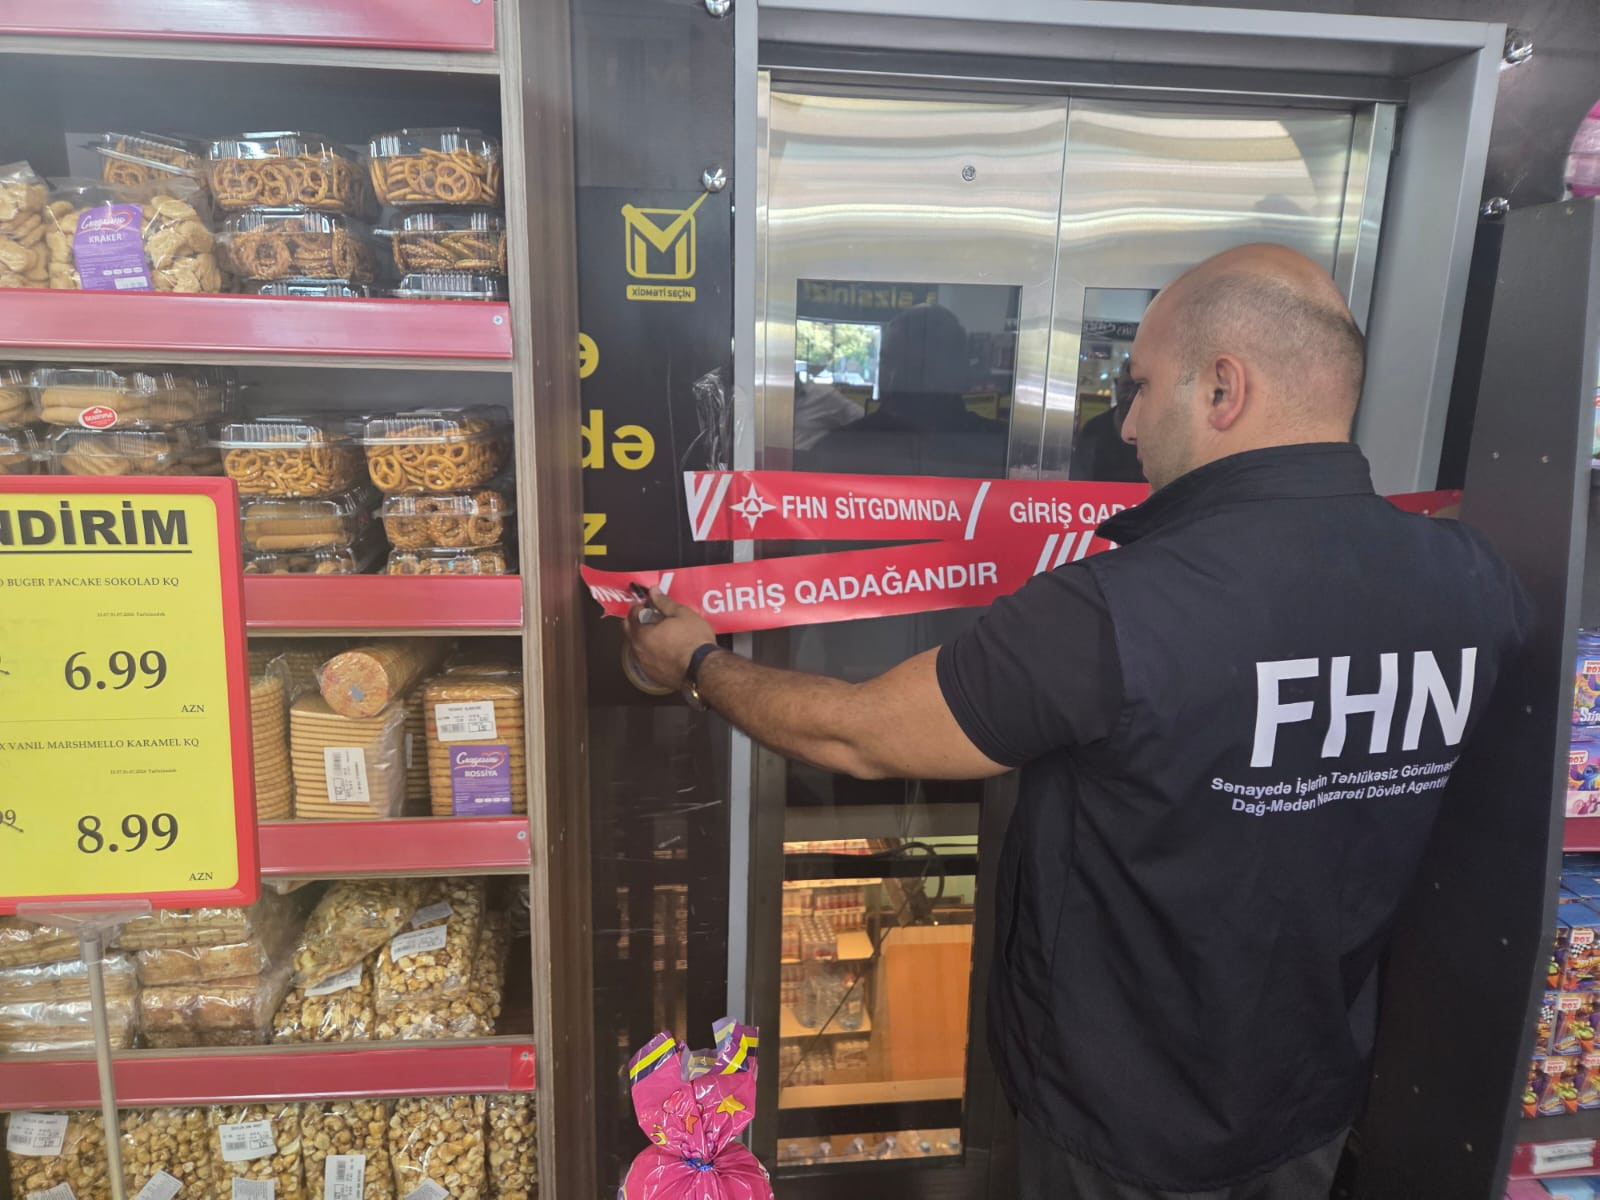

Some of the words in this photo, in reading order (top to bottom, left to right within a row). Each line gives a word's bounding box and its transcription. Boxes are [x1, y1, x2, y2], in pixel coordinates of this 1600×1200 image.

[782, 495, 828, 520] FHN
[835, 491, 961, 521] SİTGDMNDA
[1009, 497, 1073, 529] GİRİŞ
[1078, 503, 1138, 524] QAD
[7, 578, 45, 587] BUGER
[49, 577, 102, 587] PANCAKE
[104, 577, 160, 586] SOKOLAD
[163, 577, 179, 587] KQ
[702, 579, 786, 614] GİRİŞ
[794, 561, 998, 605] QADAĞANDIR
[64, 650, 167, 691] 6.99
[181, 704, 205, 713] AZN
[1250, 648, 1477, 767] FHN
[8, 742, 44, 750] VANIL
[47, 740, 124, 749] MARSHMELLO
[127, 739, 181, 748] KARAMEL
[184, 738, 200, 748] KQ
[1211, 777, 1292, 799] Sənayedə
[1296, 775, 1328, 799] İşlərin
[1331, 767, 1398, 785] Təhlükəsiz
[1232, 797, 1316, 817] Dağ-Mədən
[1317, 790, 1364, 806] Nəzarəti
[1367, 784, 1405, 799] Dövlət
[77, 813, 179, 853] 8.99
[189, 872, 213, 881] AZN
